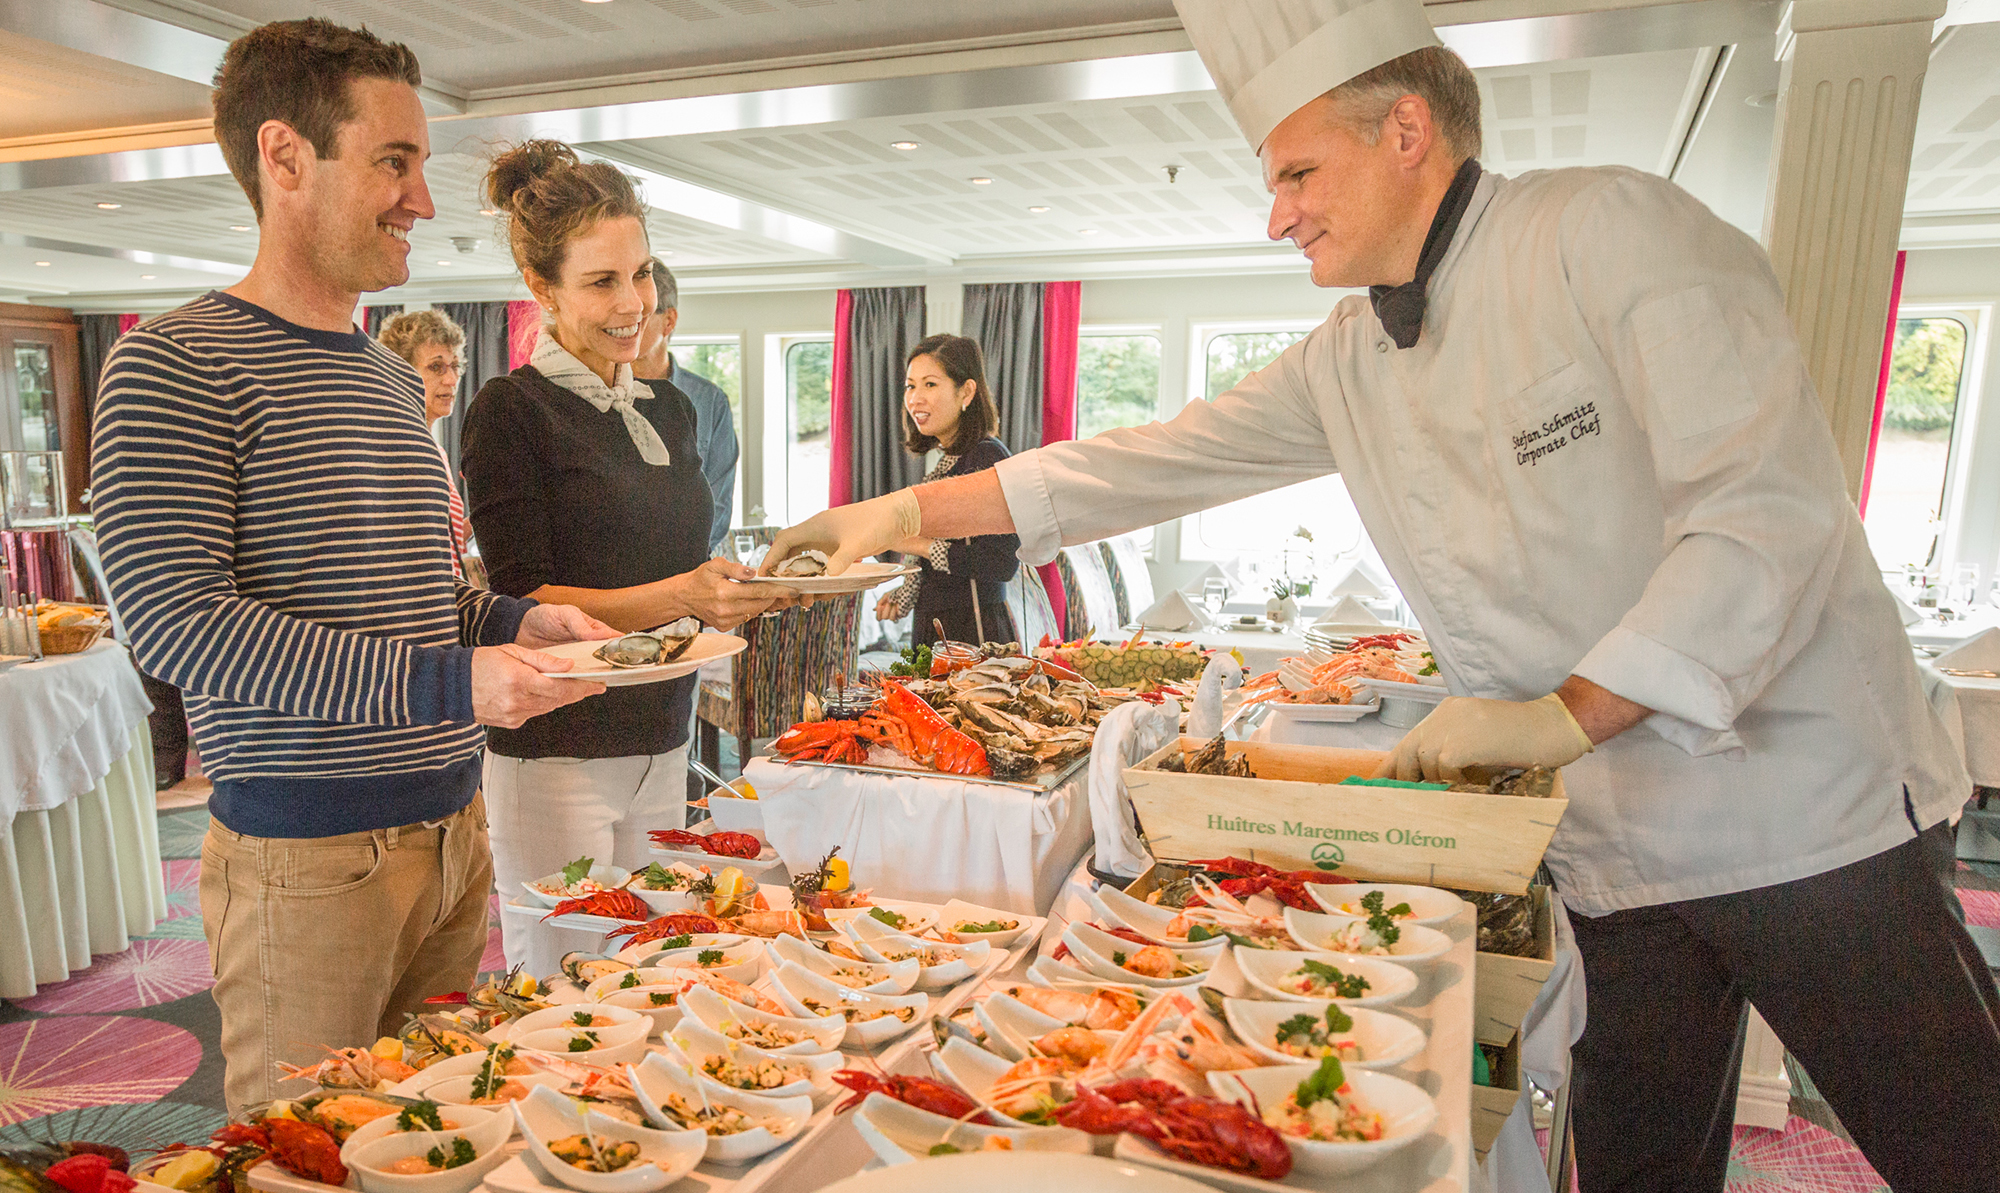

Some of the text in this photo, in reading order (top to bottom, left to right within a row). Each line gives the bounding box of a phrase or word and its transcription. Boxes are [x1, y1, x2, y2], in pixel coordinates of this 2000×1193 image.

[1512, 401, 1595, 451] Stefan Schmitz
[1517, 413, 1600, 466] Corporate Chef
[1207, 814, 1456, 849] Huîtres Marennes Oléron
